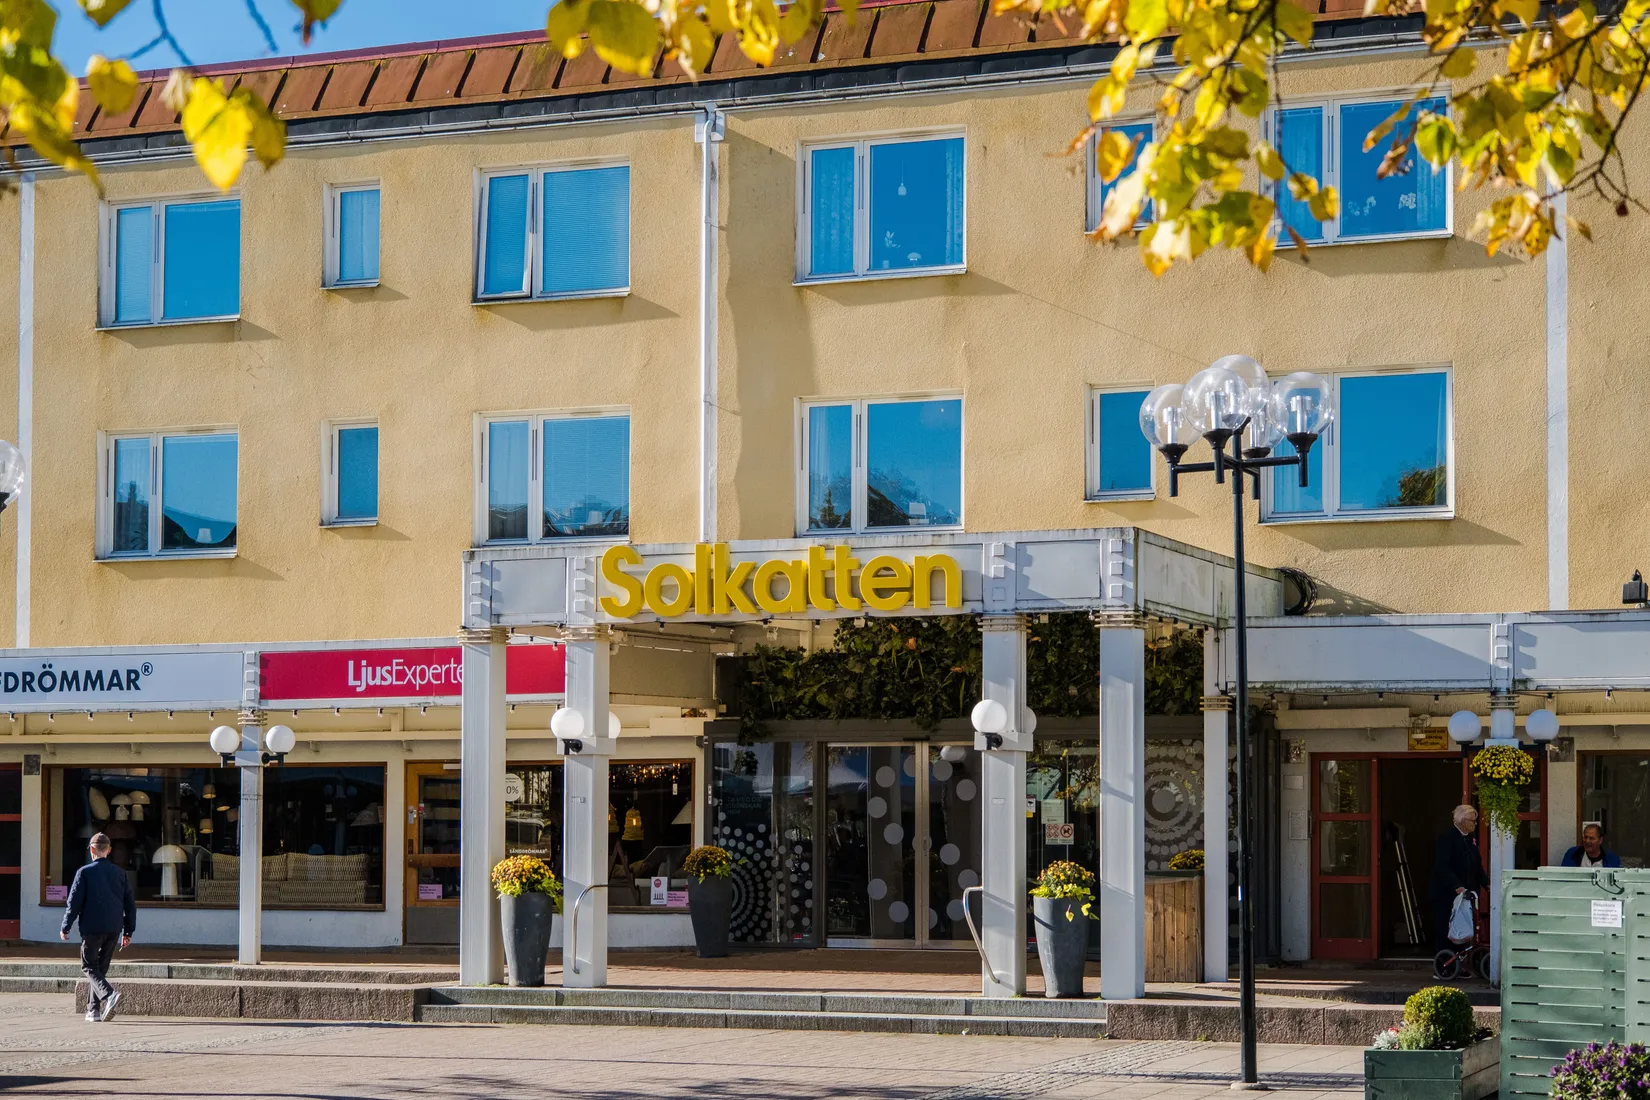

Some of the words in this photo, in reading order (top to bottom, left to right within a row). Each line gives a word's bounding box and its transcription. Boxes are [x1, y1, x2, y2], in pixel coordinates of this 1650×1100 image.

[600, 543, 963, 618] Solkatten
[0, 662, 153, 693] DRÖMMAR®
[505, 785, 519, 794] 0%
